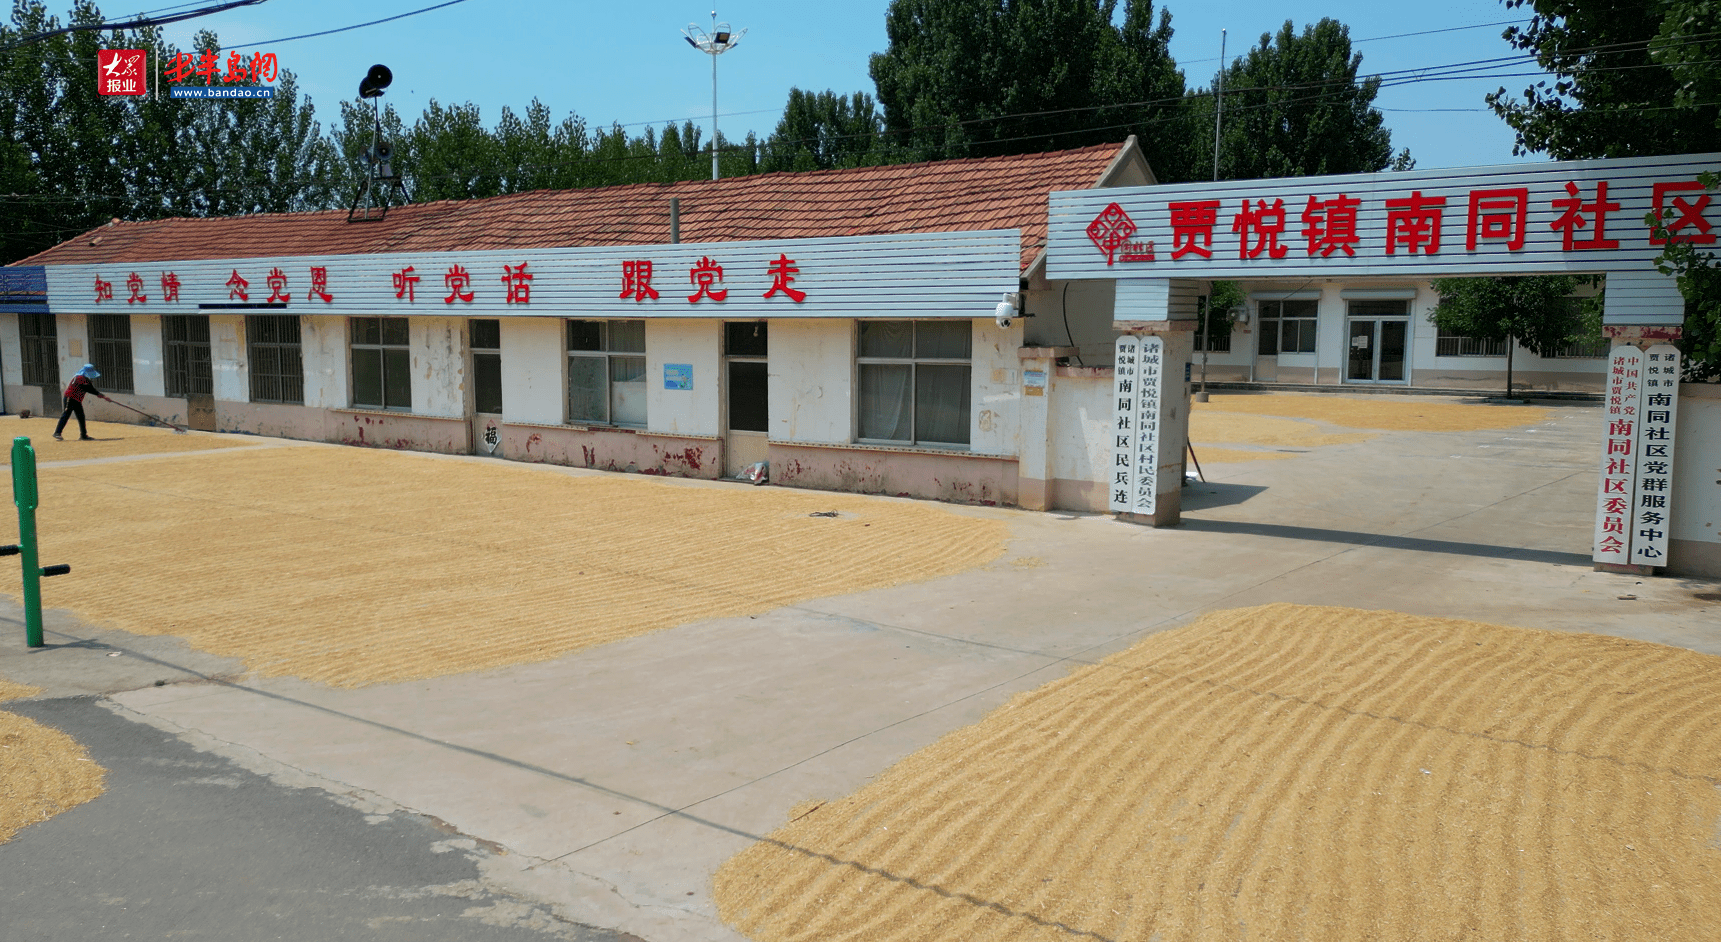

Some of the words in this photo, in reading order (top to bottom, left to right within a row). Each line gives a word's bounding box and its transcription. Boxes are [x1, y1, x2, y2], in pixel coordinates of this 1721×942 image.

[1169, 181, 1717, 260] 贾悦镇南同社区
[94, 272, 181, 304] 知党情
[225, 266, 333, 303] 念党恩
[393, 262, 533, 304] 听党话
[619, 253, 807, 304] 跟党走
[1126, 344, 1135, 376] 诸城市
[1609, 356, 1624, 416] 诸城市贾悦镇
[1623, 356, 1639, 416] 中国共产党
[1647, 353, 1660, 388] 贾悦镇
[1662, 353, 1675, 388] 诸城市
[485, 426, 498, 445] 福
[1113, 379, 1132, 504] 南同社区民兵连
[1599, 418, 1635, 554] 南同社区委员会
[1637, 392, 1672, 559] 南同社区党群服务中心
